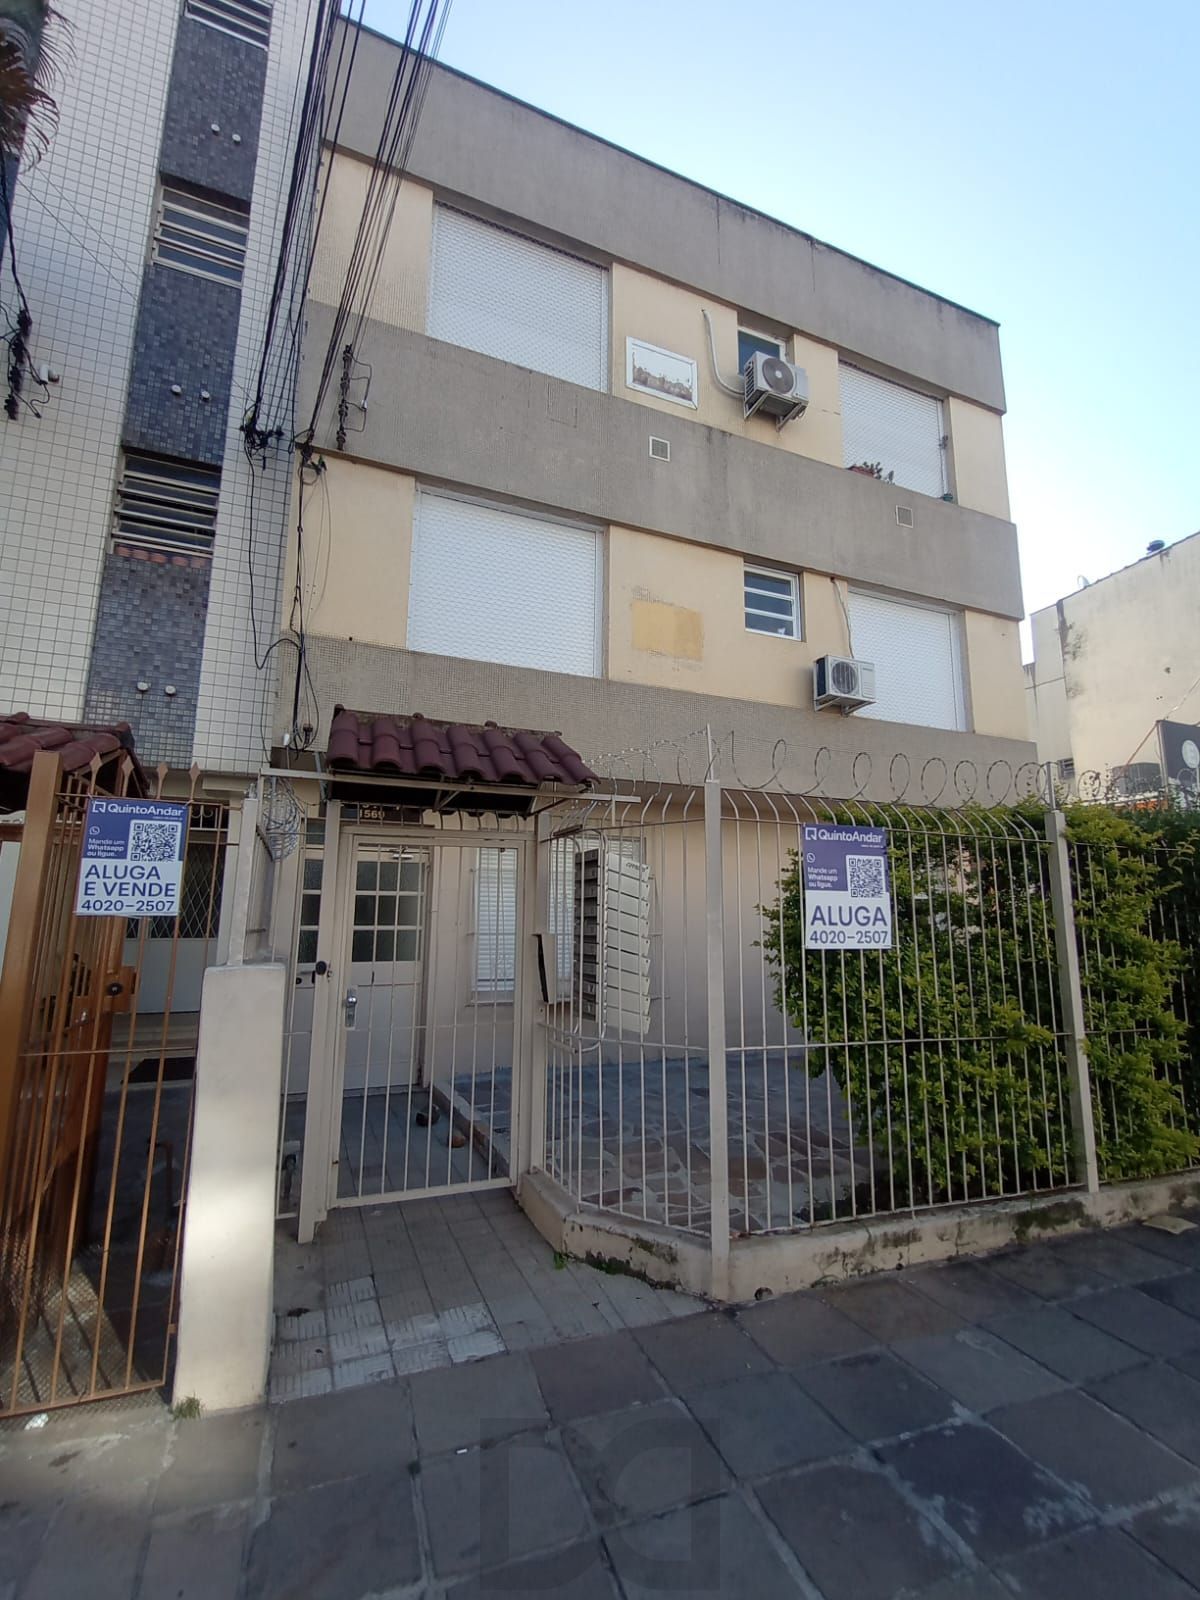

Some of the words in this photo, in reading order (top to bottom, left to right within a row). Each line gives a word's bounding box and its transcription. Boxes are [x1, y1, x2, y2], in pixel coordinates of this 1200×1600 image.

[108, 803, 183, 816] QuintoAndar
[818, 829, 883, 843] QuintoAndar
[84, 864, 161, 880] ALUGA
[84, 881, 96, 896] E
[103, 882, 176, 897] VENDE
[81, 899, 175, 912] 4020-2507
[810, 905, 888, 927] ALUGA
[810, 930, 888, 944] 4020-2507
